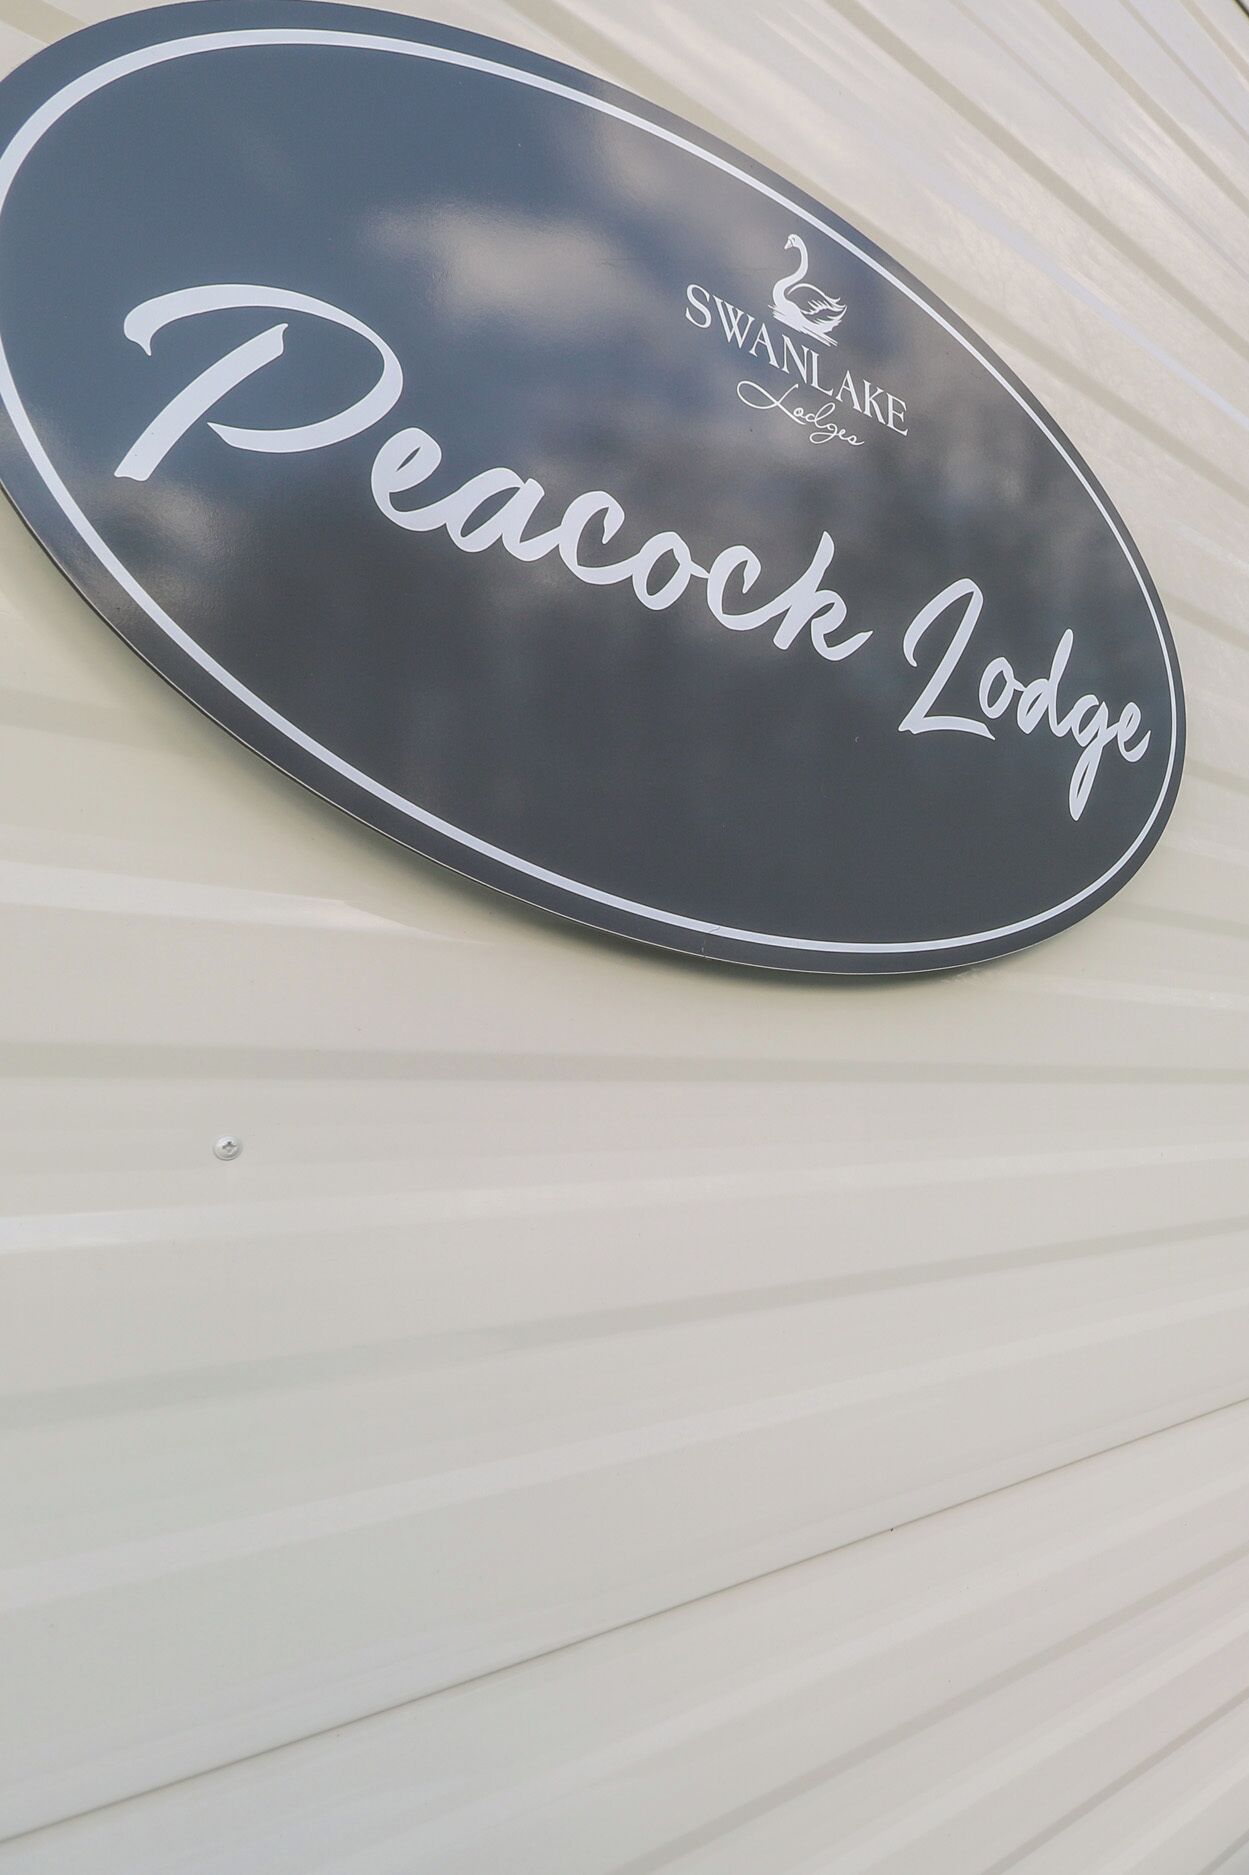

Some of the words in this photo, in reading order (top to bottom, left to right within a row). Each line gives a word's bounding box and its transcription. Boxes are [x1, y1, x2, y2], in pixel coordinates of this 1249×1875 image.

[684, 284, 909, 437] SWANLAKE
[736, 380, 865, 446] Lodges
[113, 283, 874, 661] Peacock
[898, 578, 1152, 822] Lodge
